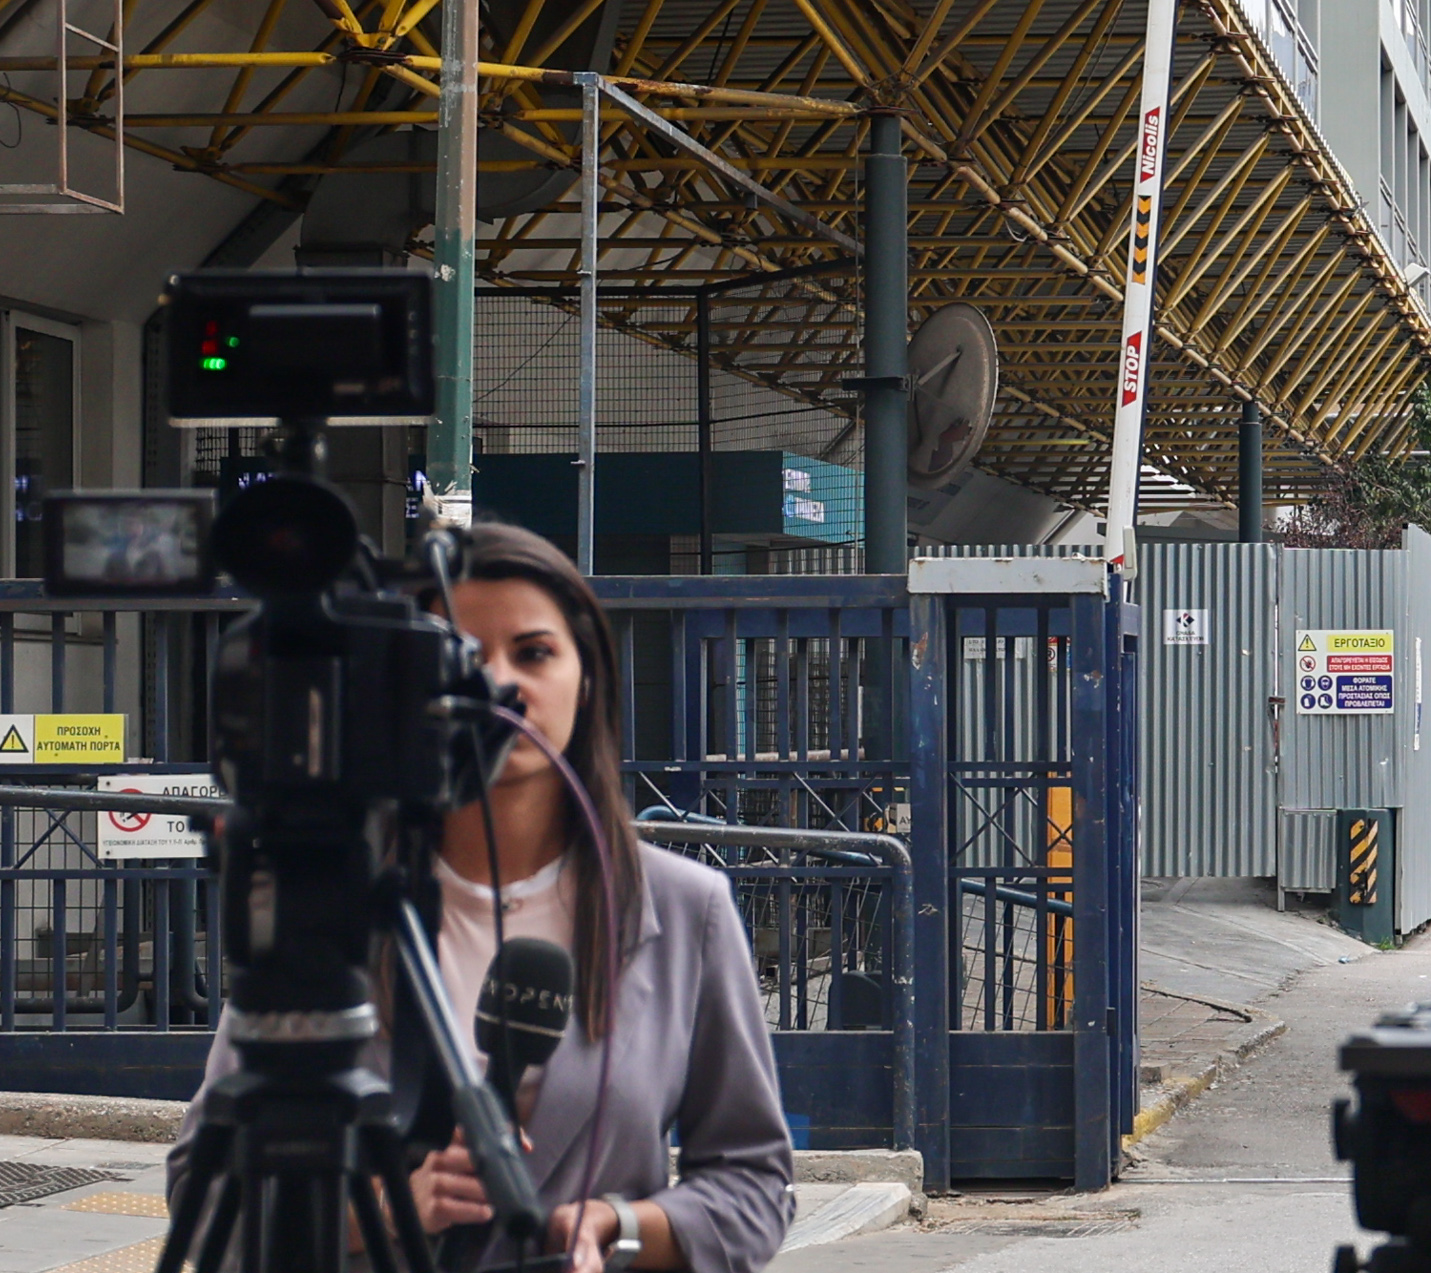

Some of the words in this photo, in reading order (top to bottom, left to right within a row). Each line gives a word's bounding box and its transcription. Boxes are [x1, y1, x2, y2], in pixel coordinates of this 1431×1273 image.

[1141, 115, 1159, 175] Nicolis
[1124, 345, 1139, 393] STOP
[1334, 638, 1386, 648] ΕΡΓΟΤΑΞΙΟ
[57, 726, 101, 736] ΠΡΟΣΟΧΗ
[36, 741, 88, 751] ΑΥΤΟΜΑΤΗ
[90, 741, 120, 751] ΠΟΡΤΑ
